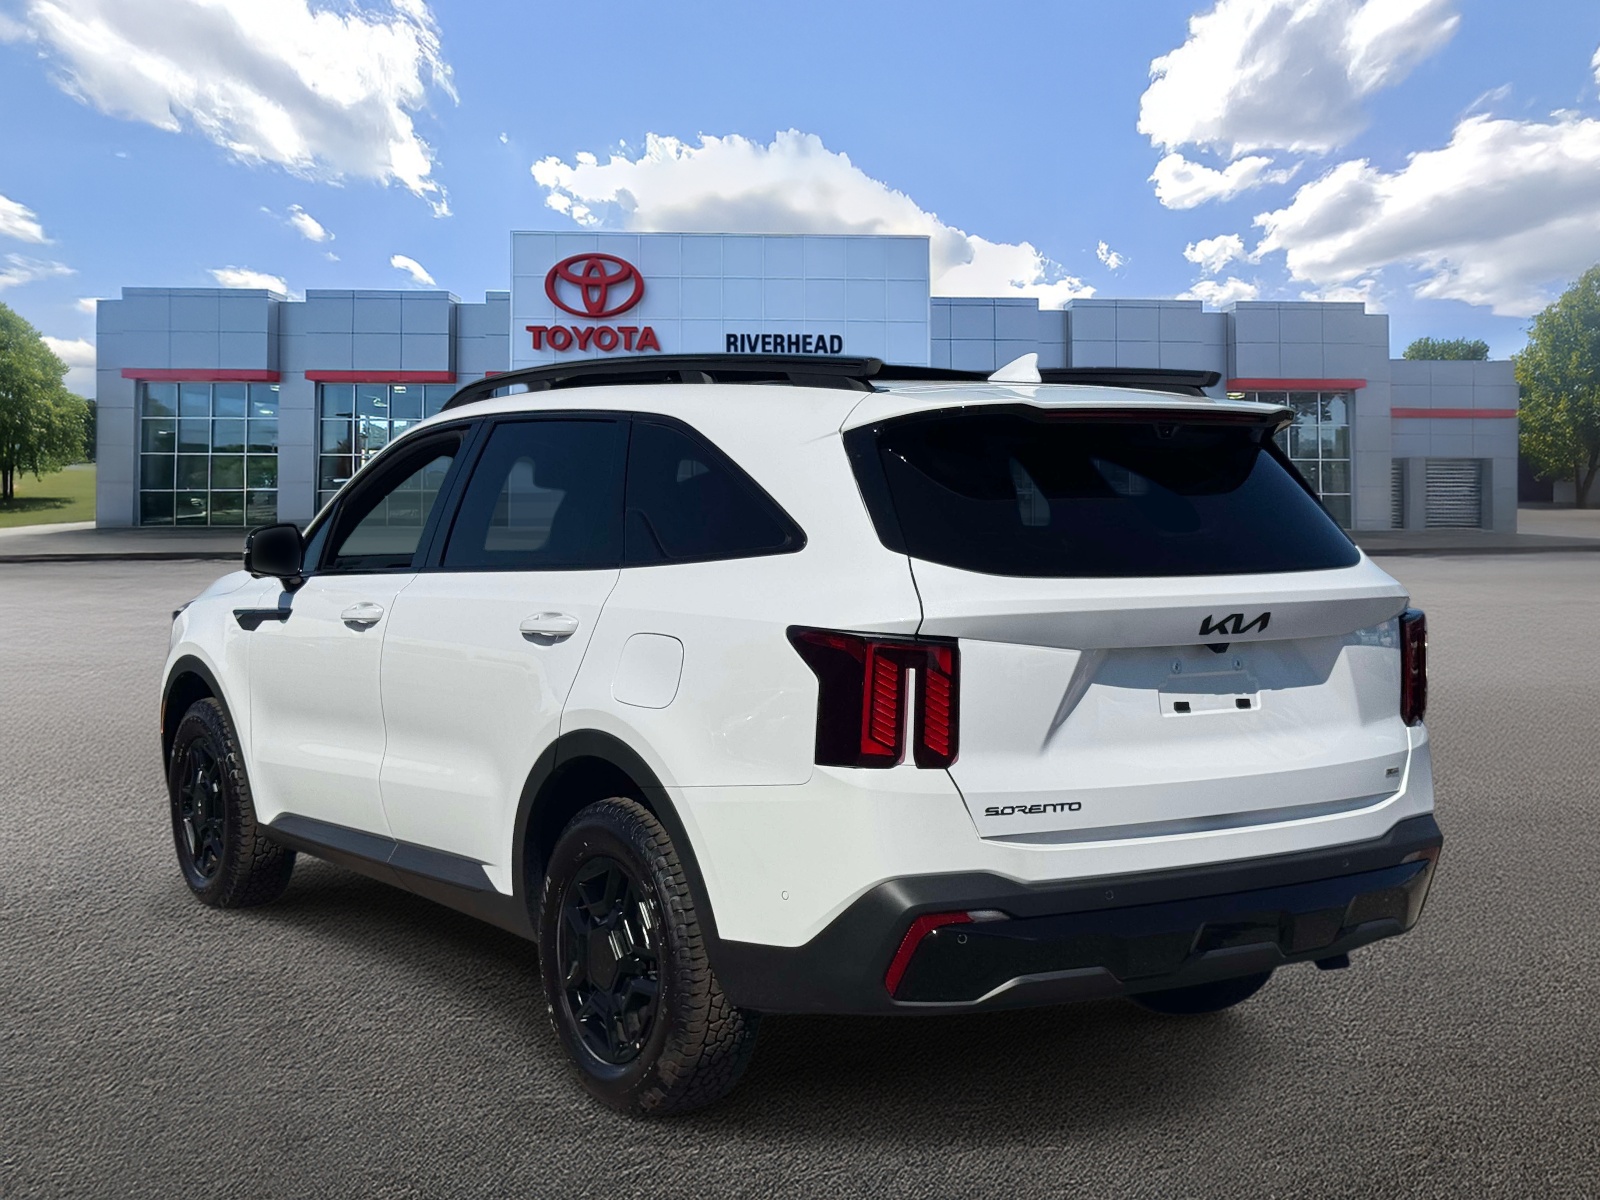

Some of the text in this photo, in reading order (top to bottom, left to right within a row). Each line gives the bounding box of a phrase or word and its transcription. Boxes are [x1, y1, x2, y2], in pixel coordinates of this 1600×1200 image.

[526, 326, 661, 352] TOYOTA
[726, 333, 843, 354] RIVERHEAD
[984, 801, 1082, 816] SORENTO
